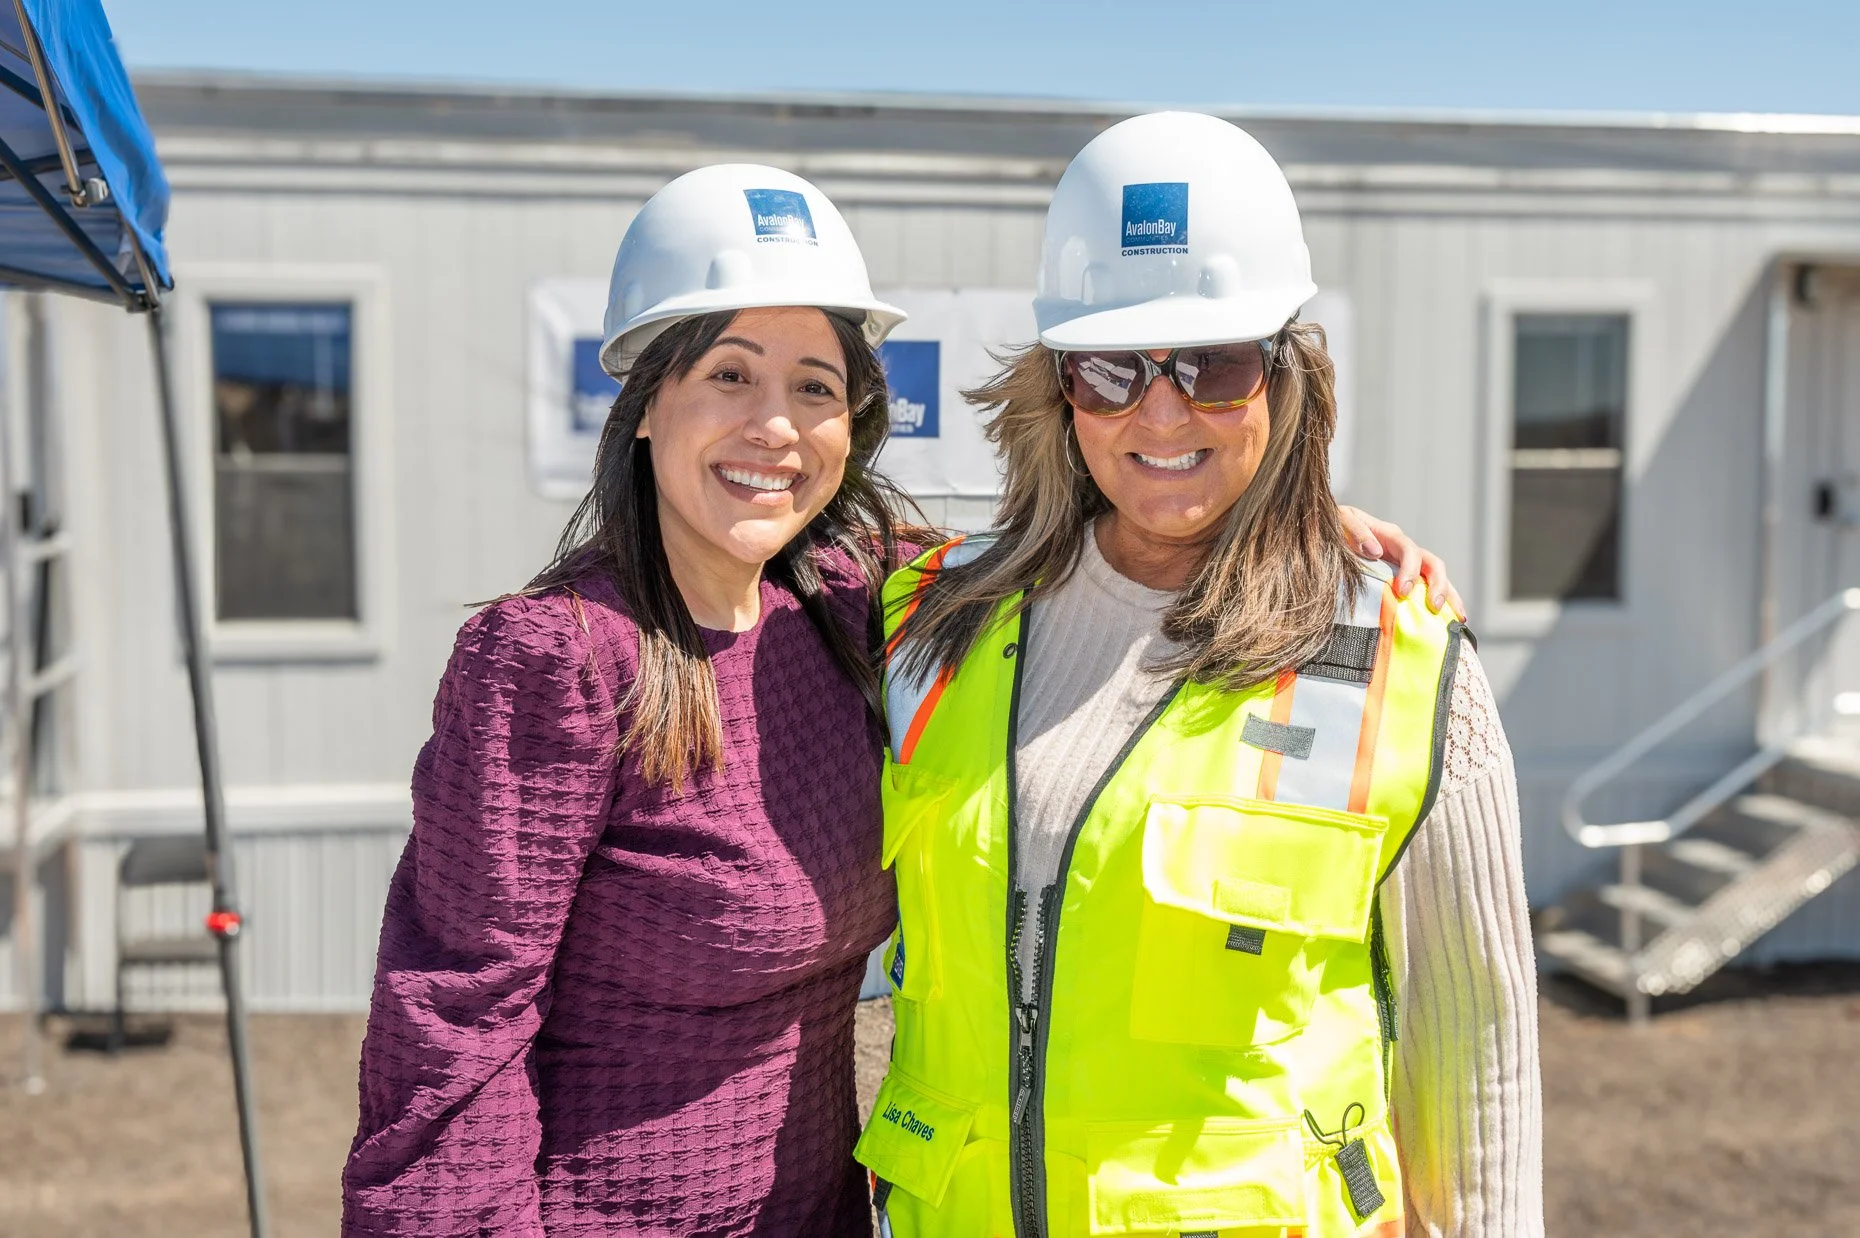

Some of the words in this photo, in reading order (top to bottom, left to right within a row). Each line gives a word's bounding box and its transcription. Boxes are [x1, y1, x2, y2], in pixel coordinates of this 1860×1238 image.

[757, 213, 805, 227] AvalonBay
[1125, 218, 1177, 237] AvalonBay
[756, 236, 819, 247] CONSTRUCION
[1121, 247, 1189, 257] CONSTRUCTION
[882, 1101, 902, 1124] Lisa
[901, 1110, 935, 1141] Chaves
